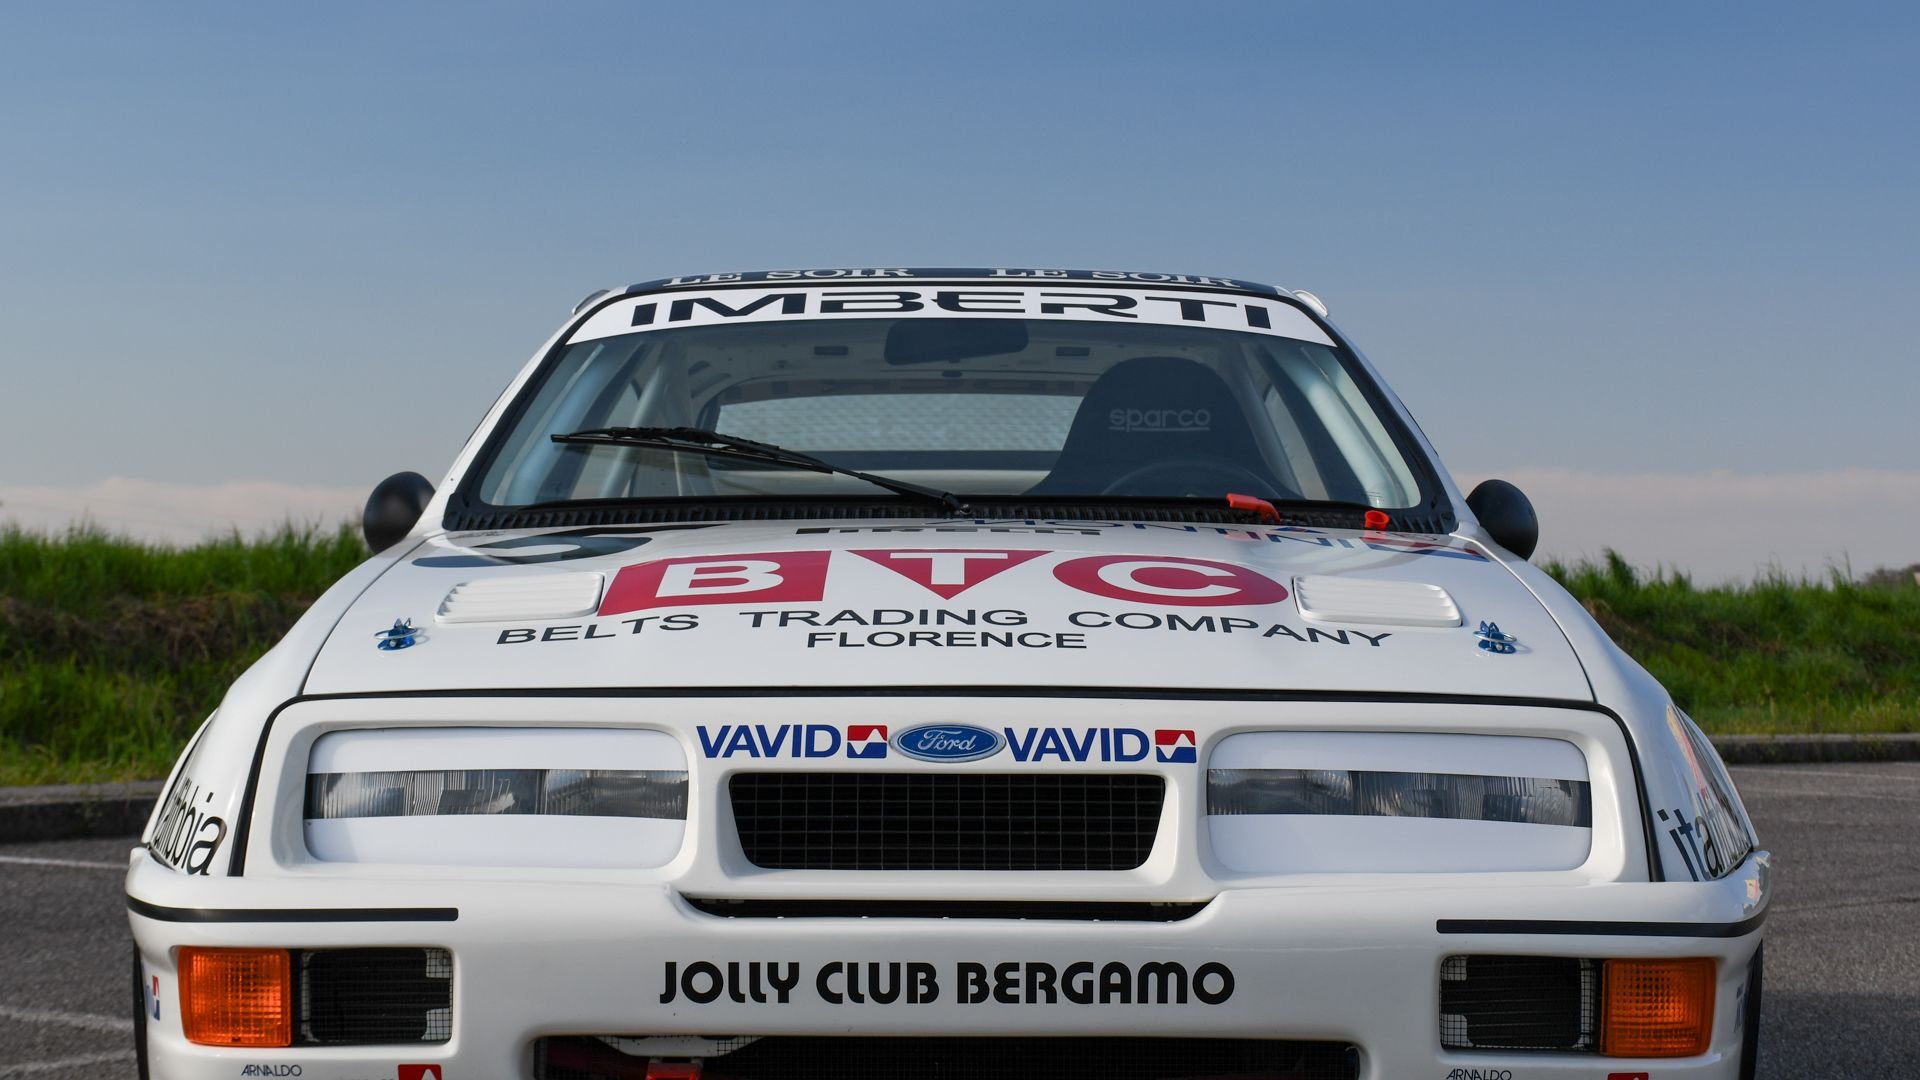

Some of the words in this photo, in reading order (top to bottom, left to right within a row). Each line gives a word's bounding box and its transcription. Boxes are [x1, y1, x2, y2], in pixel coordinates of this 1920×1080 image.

[663, 272, 742, 287] LE
[766, 268, 914, 280] SOIR
[990, 268, 1068, 278] LE
[1092, 271, 1241, 288] SOIR
[631, 291, 1272, 329] IMBERTI
[1109, 408, 1211, 432] sparco
[497, 613, 700, 645] BELTS
[739, 608, 1028, 628] TRADING
[1067, 610, 1393, 648] COMPANY
[807, 632, 1087, 649] FLORENCE
[696, 725, 842, 758] VAVID
[1004, 727, 1150, 762] VAVID
[659, 961, 800, 1004] JOLLY
[815, 961, 940, 1004] CLUB
[957, 961, 1235, 1005] BERGAMO
[241, 1064, 302, 1077] ARNALDO
[1446, 1068, 1512, 1080] ARNALDO
